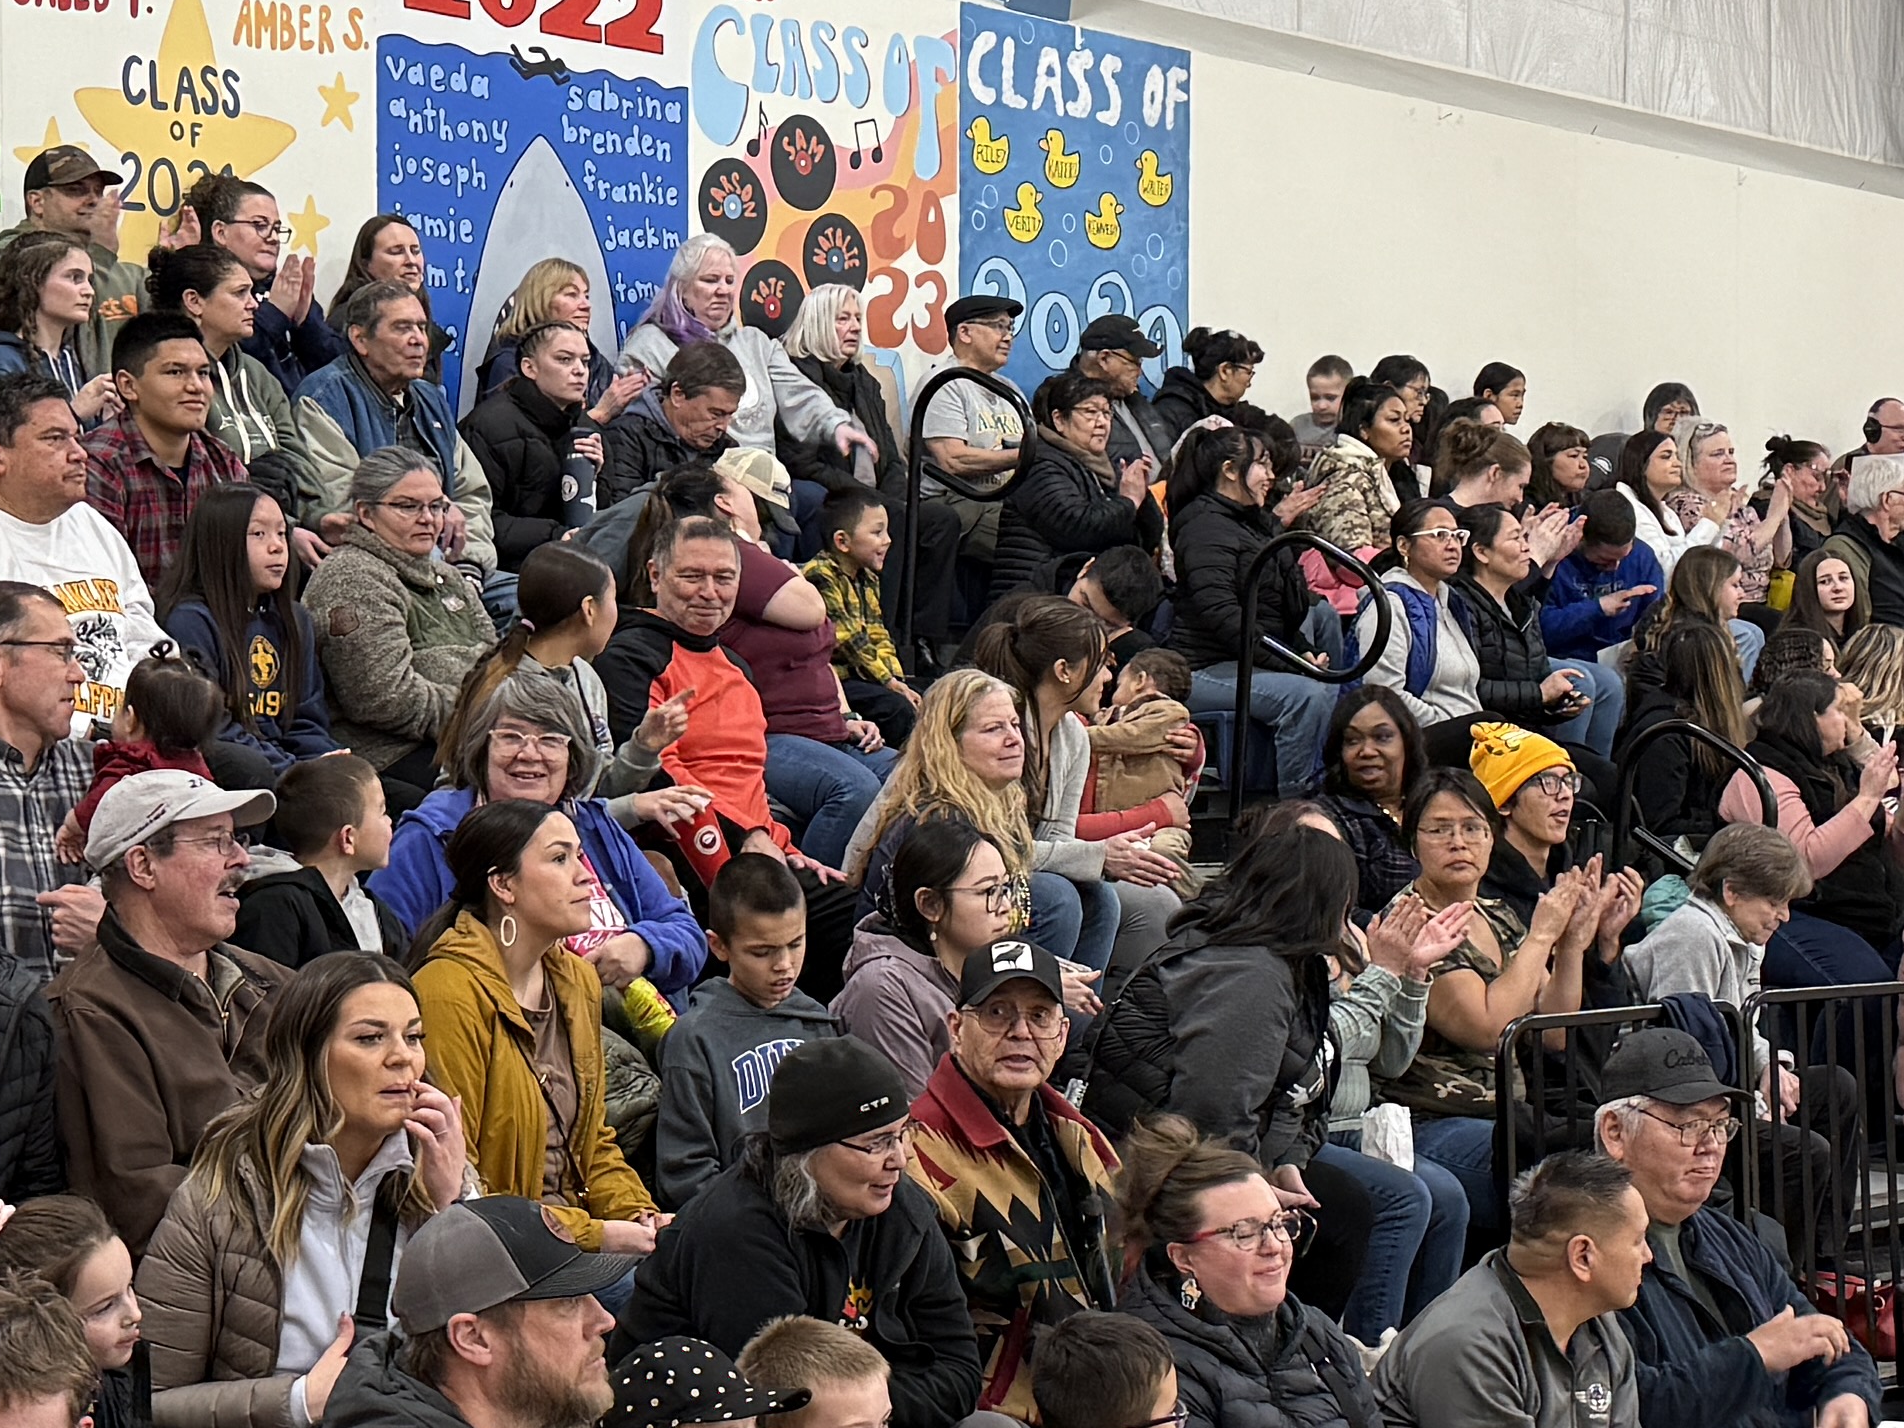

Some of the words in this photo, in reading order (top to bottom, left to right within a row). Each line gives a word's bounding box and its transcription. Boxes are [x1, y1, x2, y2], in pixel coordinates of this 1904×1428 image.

[342, 7, 370, 51] S.
[122, 54, 241, 118] CLASS
[567, 83, 682, 123] sabrina
[691, 4, 871, 146] CLASS
[883, 33, 956, 181] OF
[967, 30, 1122, 126] CLASS
[1143, 64, 1189, 130] OF
[169, 120, 203, 148] OF
[389, 96, 509, 154] anthony
[561, 114, 671, 163] brenden
[782, 128, 826, 163] SAM
[389, 144, 487, 197] joseph
[583, 159, 679, 207] frankie
[708, 171, 757, 219] CARSON
[812, 227, 861, 270] NATALIE
[870, 183, 947, 266] 20
[751, 276, 786, 304] TATE
[867, 266, 948, 356] 23
